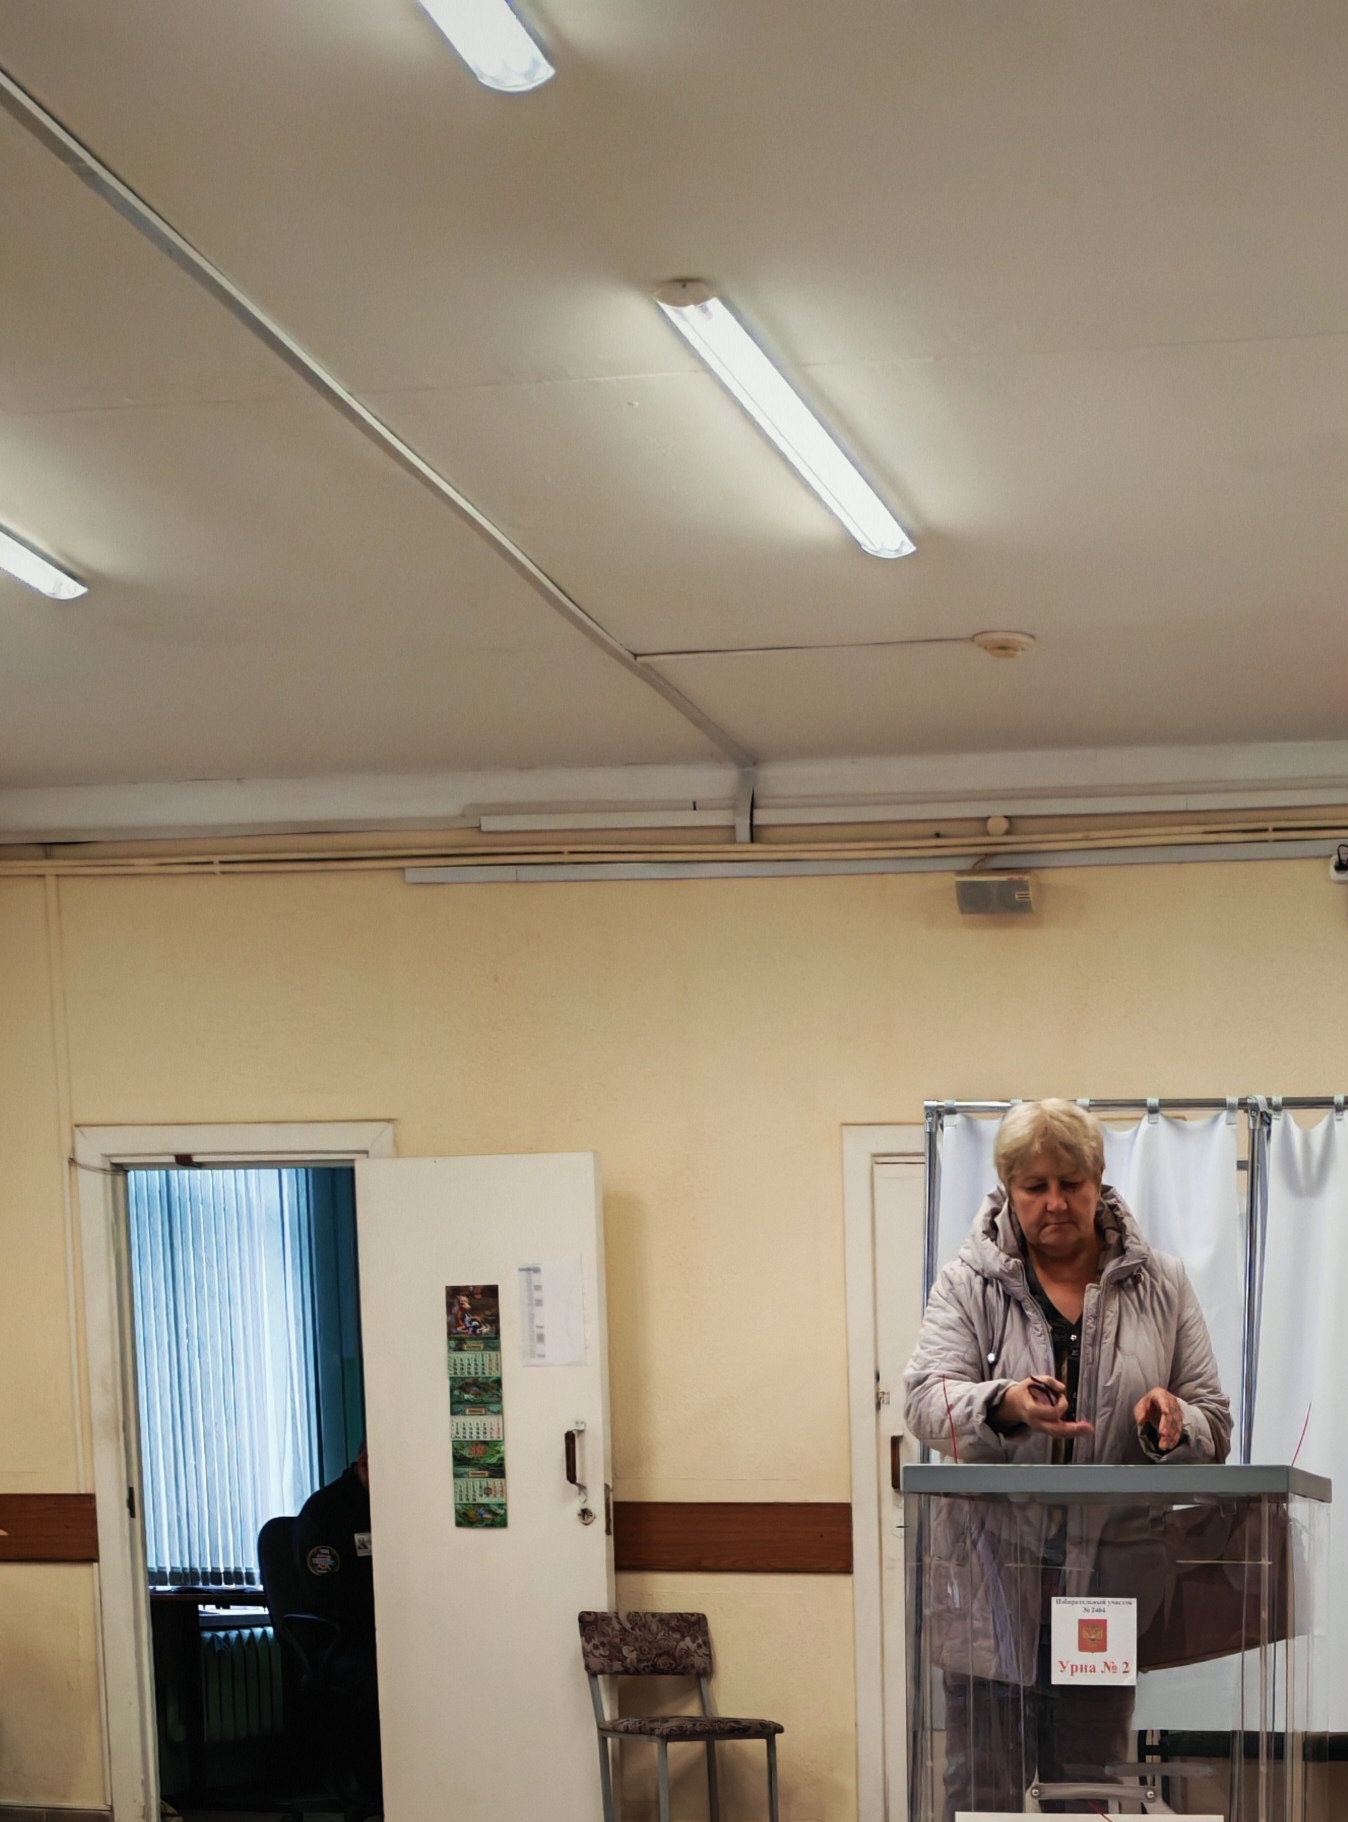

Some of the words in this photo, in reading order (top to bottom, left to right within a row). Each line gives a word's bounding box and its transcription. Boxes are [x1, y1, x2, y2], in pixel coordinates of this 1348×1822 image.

[1058, 1660, 1096, 1677] Урна
[1100, 1661, 1118, 1674] №
[1121, 1661, 1130, 1674] 2
